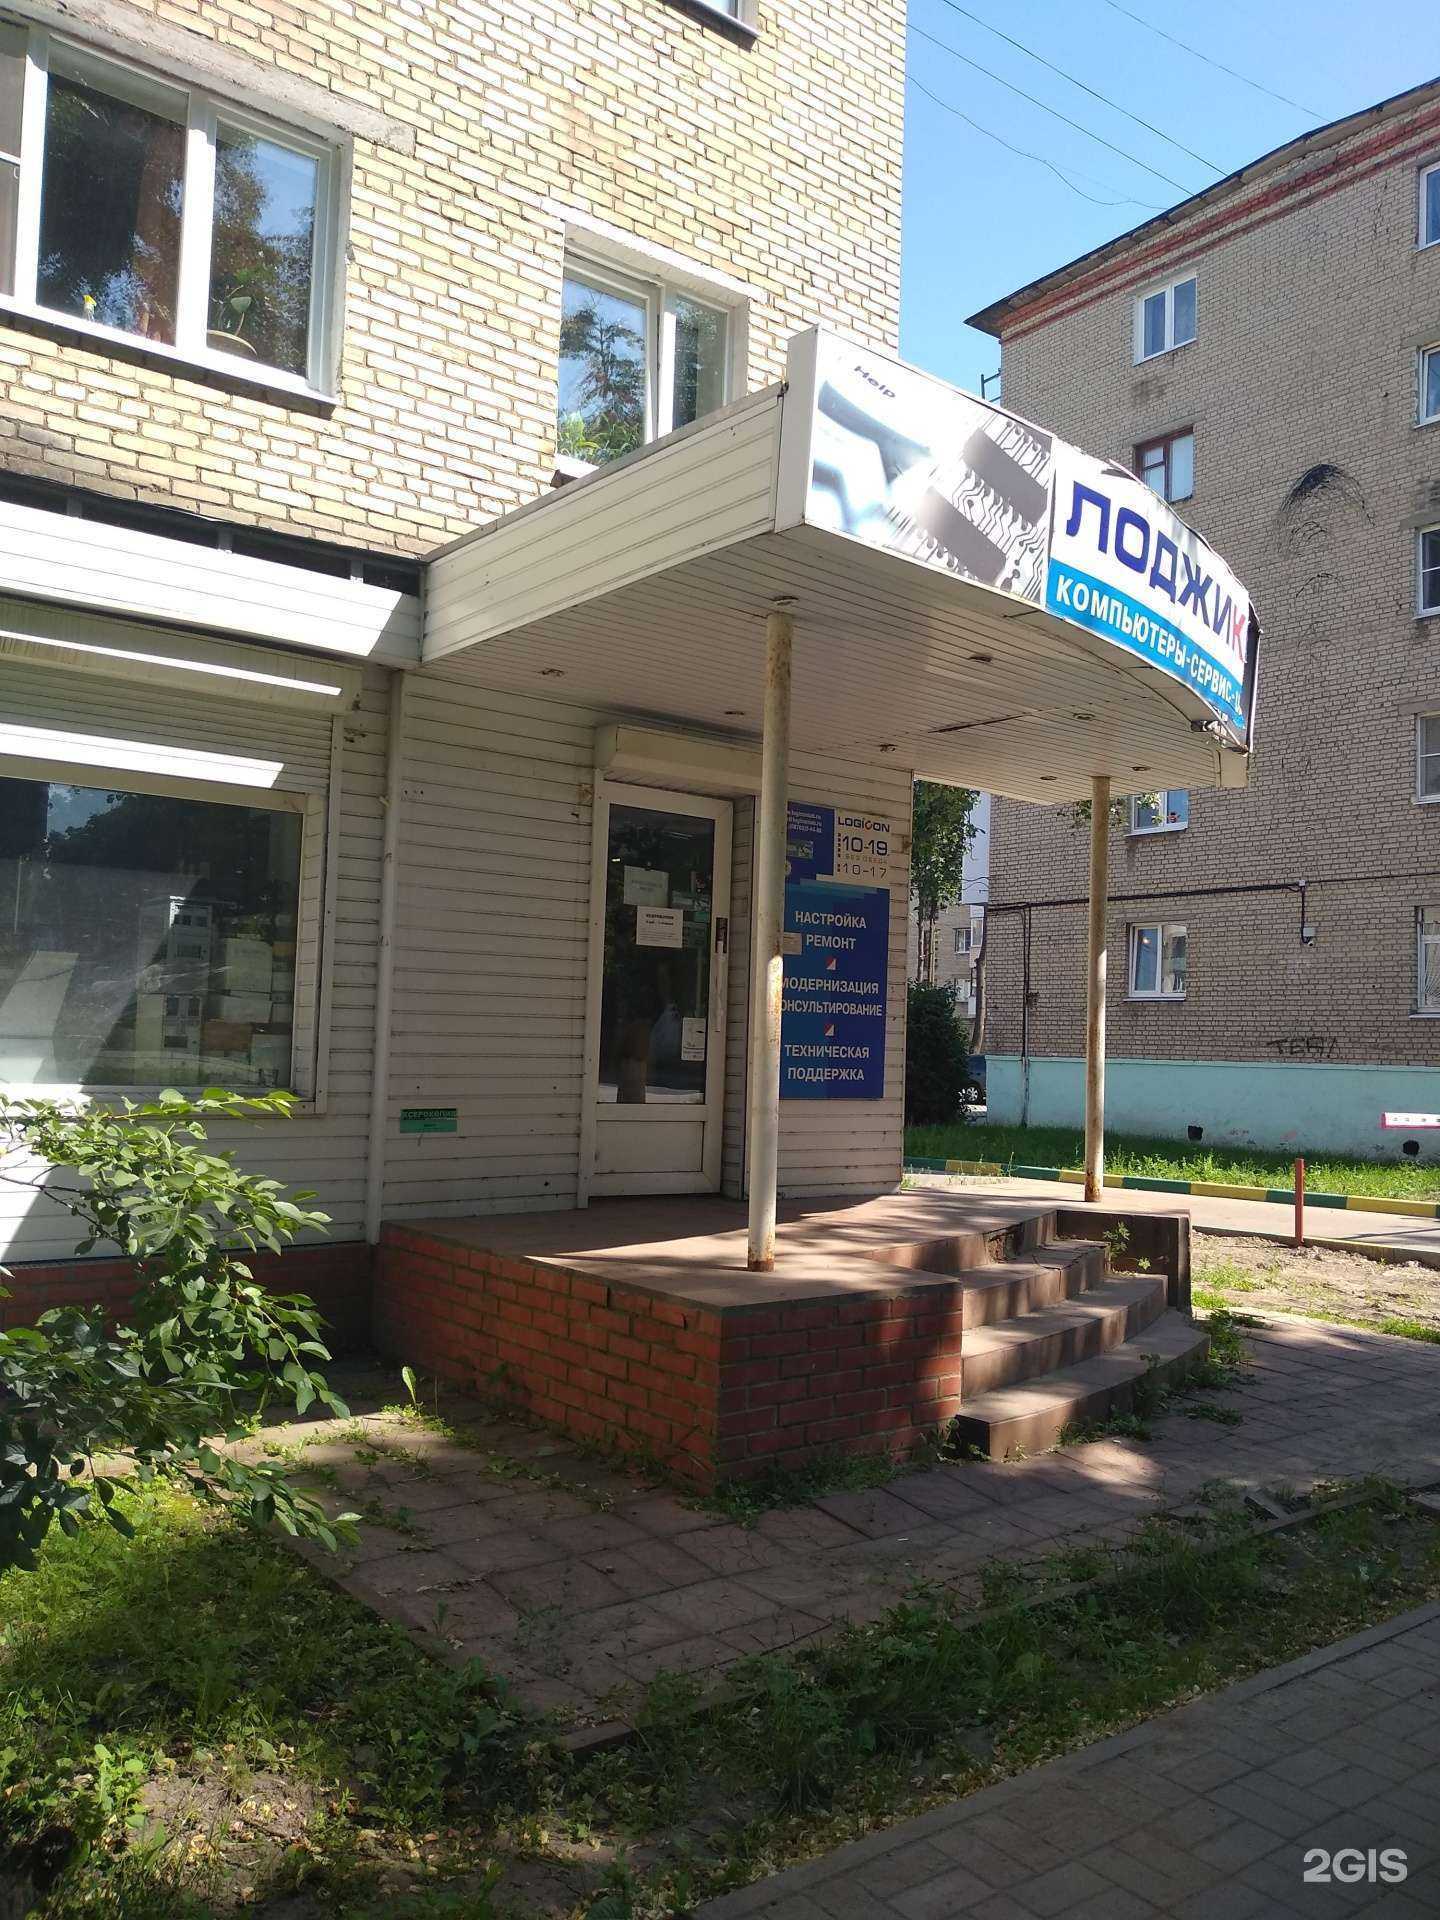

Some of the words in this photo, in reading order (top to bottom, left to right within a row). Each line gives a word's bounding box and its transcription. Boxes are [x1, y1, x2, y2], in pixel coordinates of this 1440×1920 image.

[854, 365, 896, 398] Help
[843, 836, 888, 856] 10-19
[843, 863, 887, 878] 10-17
[795, 911, 867, 929] НАСТРОЙКА
[806, 934, 857, 950] РЕМОНТ
[781, 999, 883, 1016] ОНСУЛЬТИРОВАНИЕ
[784, 1044, 870, 1059] ТЕХНИЧЕСКАЯ
[787, 1067, 865, 1082] ПОДДЕРЖКА
